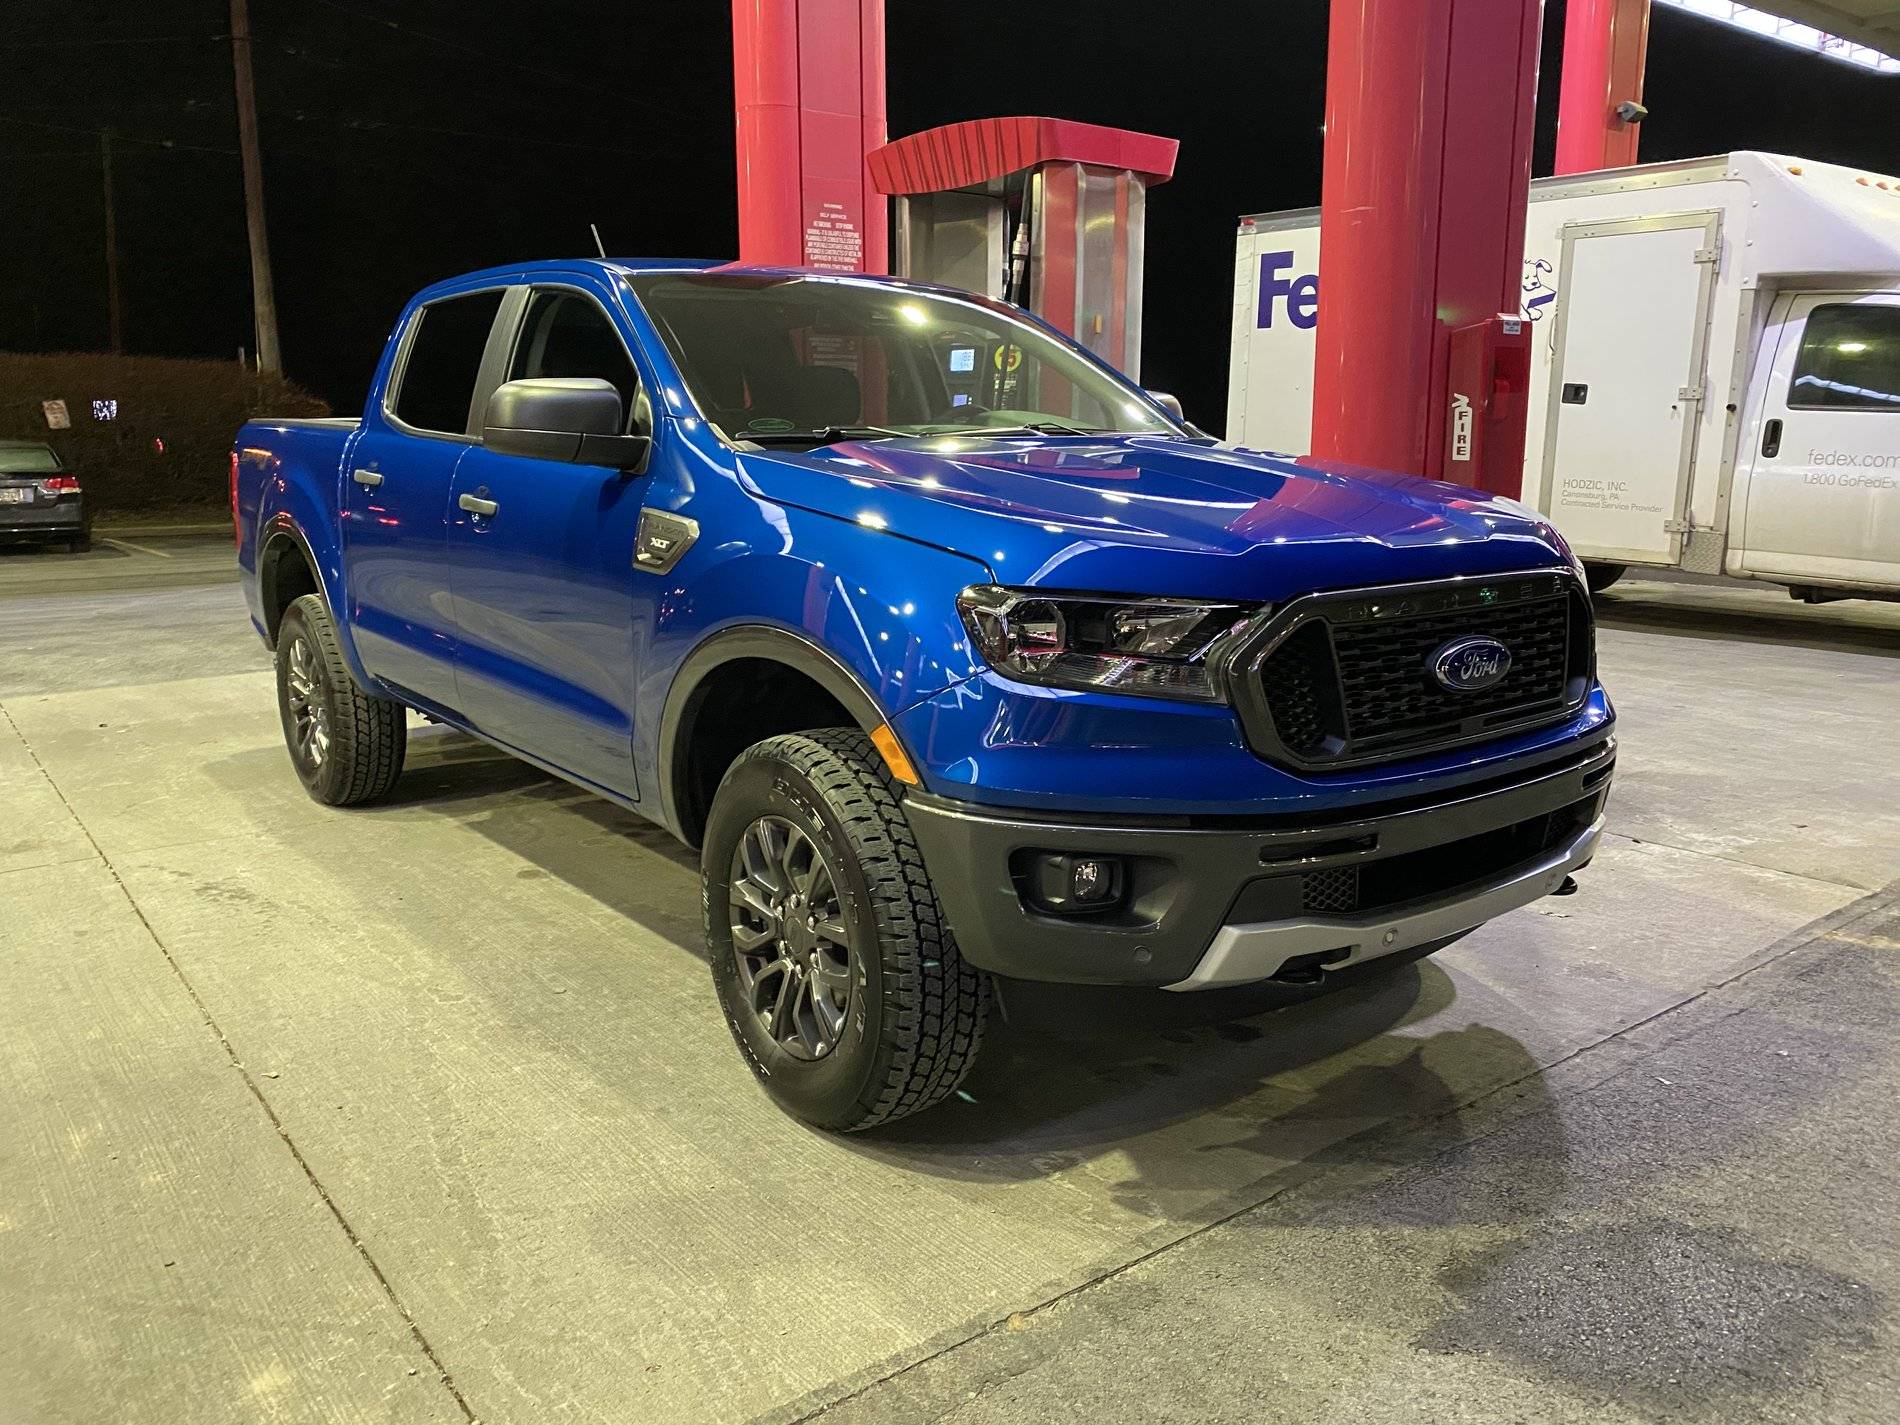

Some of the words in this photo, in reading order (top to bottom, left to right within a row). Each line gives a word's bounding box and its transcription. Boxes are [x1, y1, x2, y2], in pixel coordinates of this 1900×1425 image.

[1457, 411, 1469, 456] FIRE
[1807, 448, 1900, 468] fedex.com
[1461, 649, 1499, 680] Ford
